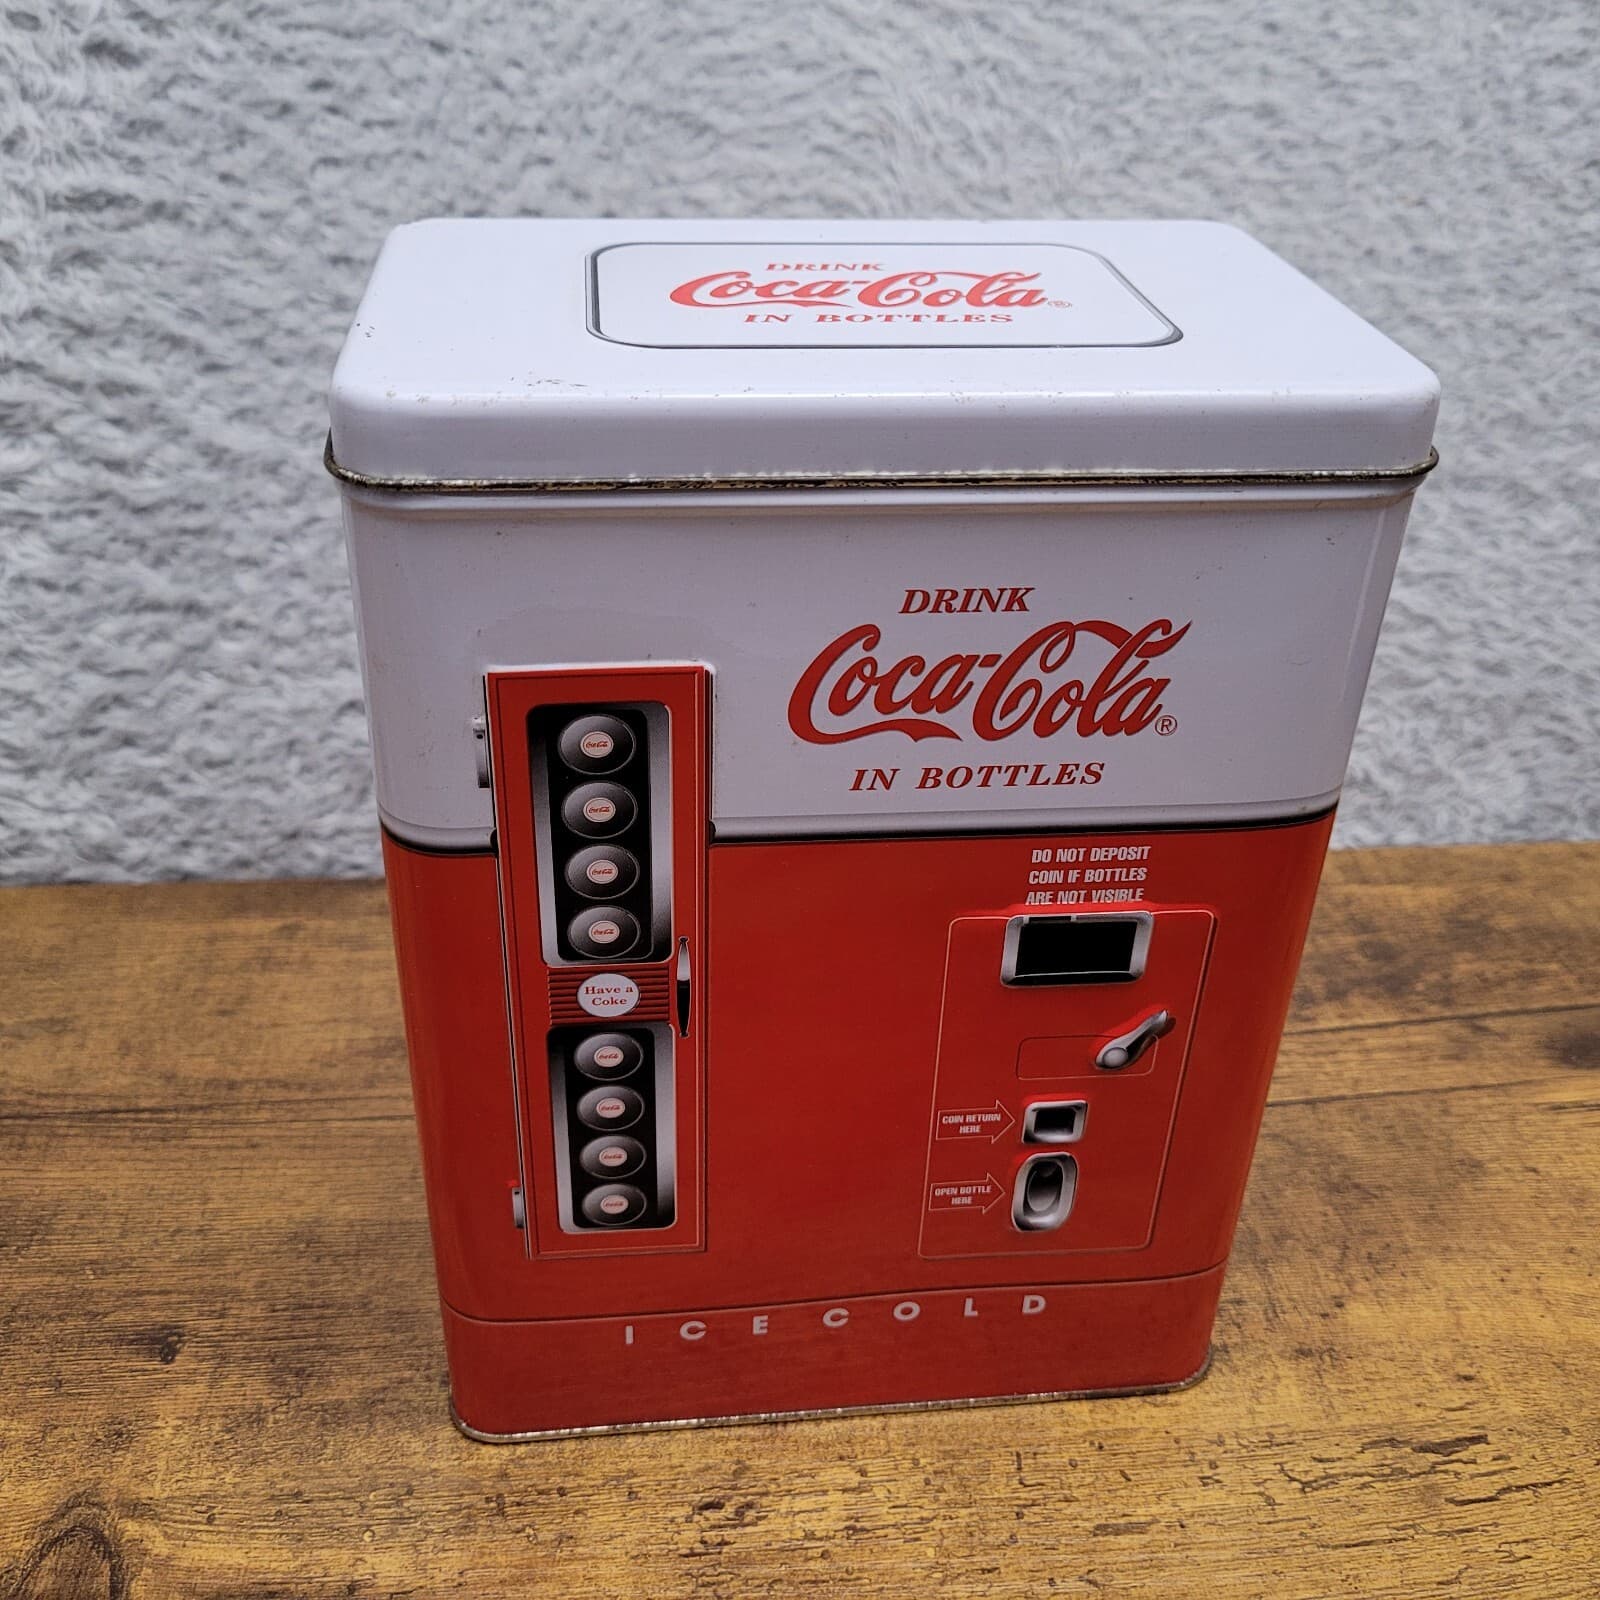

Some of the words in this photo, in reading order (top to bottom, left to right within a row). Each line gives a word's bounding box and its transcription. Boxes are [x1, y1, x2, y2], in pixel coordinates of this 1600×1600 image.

[766, 263, 885, 271] DRINK
[669, 271, 1049, 308] Coca-Cola
[744, 314, 792, 323] IN
[815, 314, 1014, 323] BOTTLES
[898, 587, 1035, 614] DRINK
[787, 618, 1192, 745] Coca-Cola
[849, 768, 900, 791] IN
[915, 762, 1105, 790] BOTTLES
[1031, 849, 1052, 863] DO
[1055, 848, 1086, 862] NOT
[1090, 846, 1151, 862] DEPOSIT
[1028, 870, 1064, 884] COIN
[1067, 870, 1081, 884] IF
[1083, 868, 1148, 883] BOTTLES
[1025, 891, 1053, 905] ARE
[1056, 890, 1087, 904] NOT
[1091, 888, 1144, 903] VISIBLE
[584, 986, 621, 995] Have
[591, 997, 627, 1006] Coke
[942, 1115, 964, 1124] COIN
[966, 1113, 1001, 1123] RETURN
[959, 1125, 981, 1134] HERE
[935, 1187, 957, 1196] OPEN
[960, 1186, 991, 1195] BOTTLE
[951, 1197, 972, 1205] HERE
